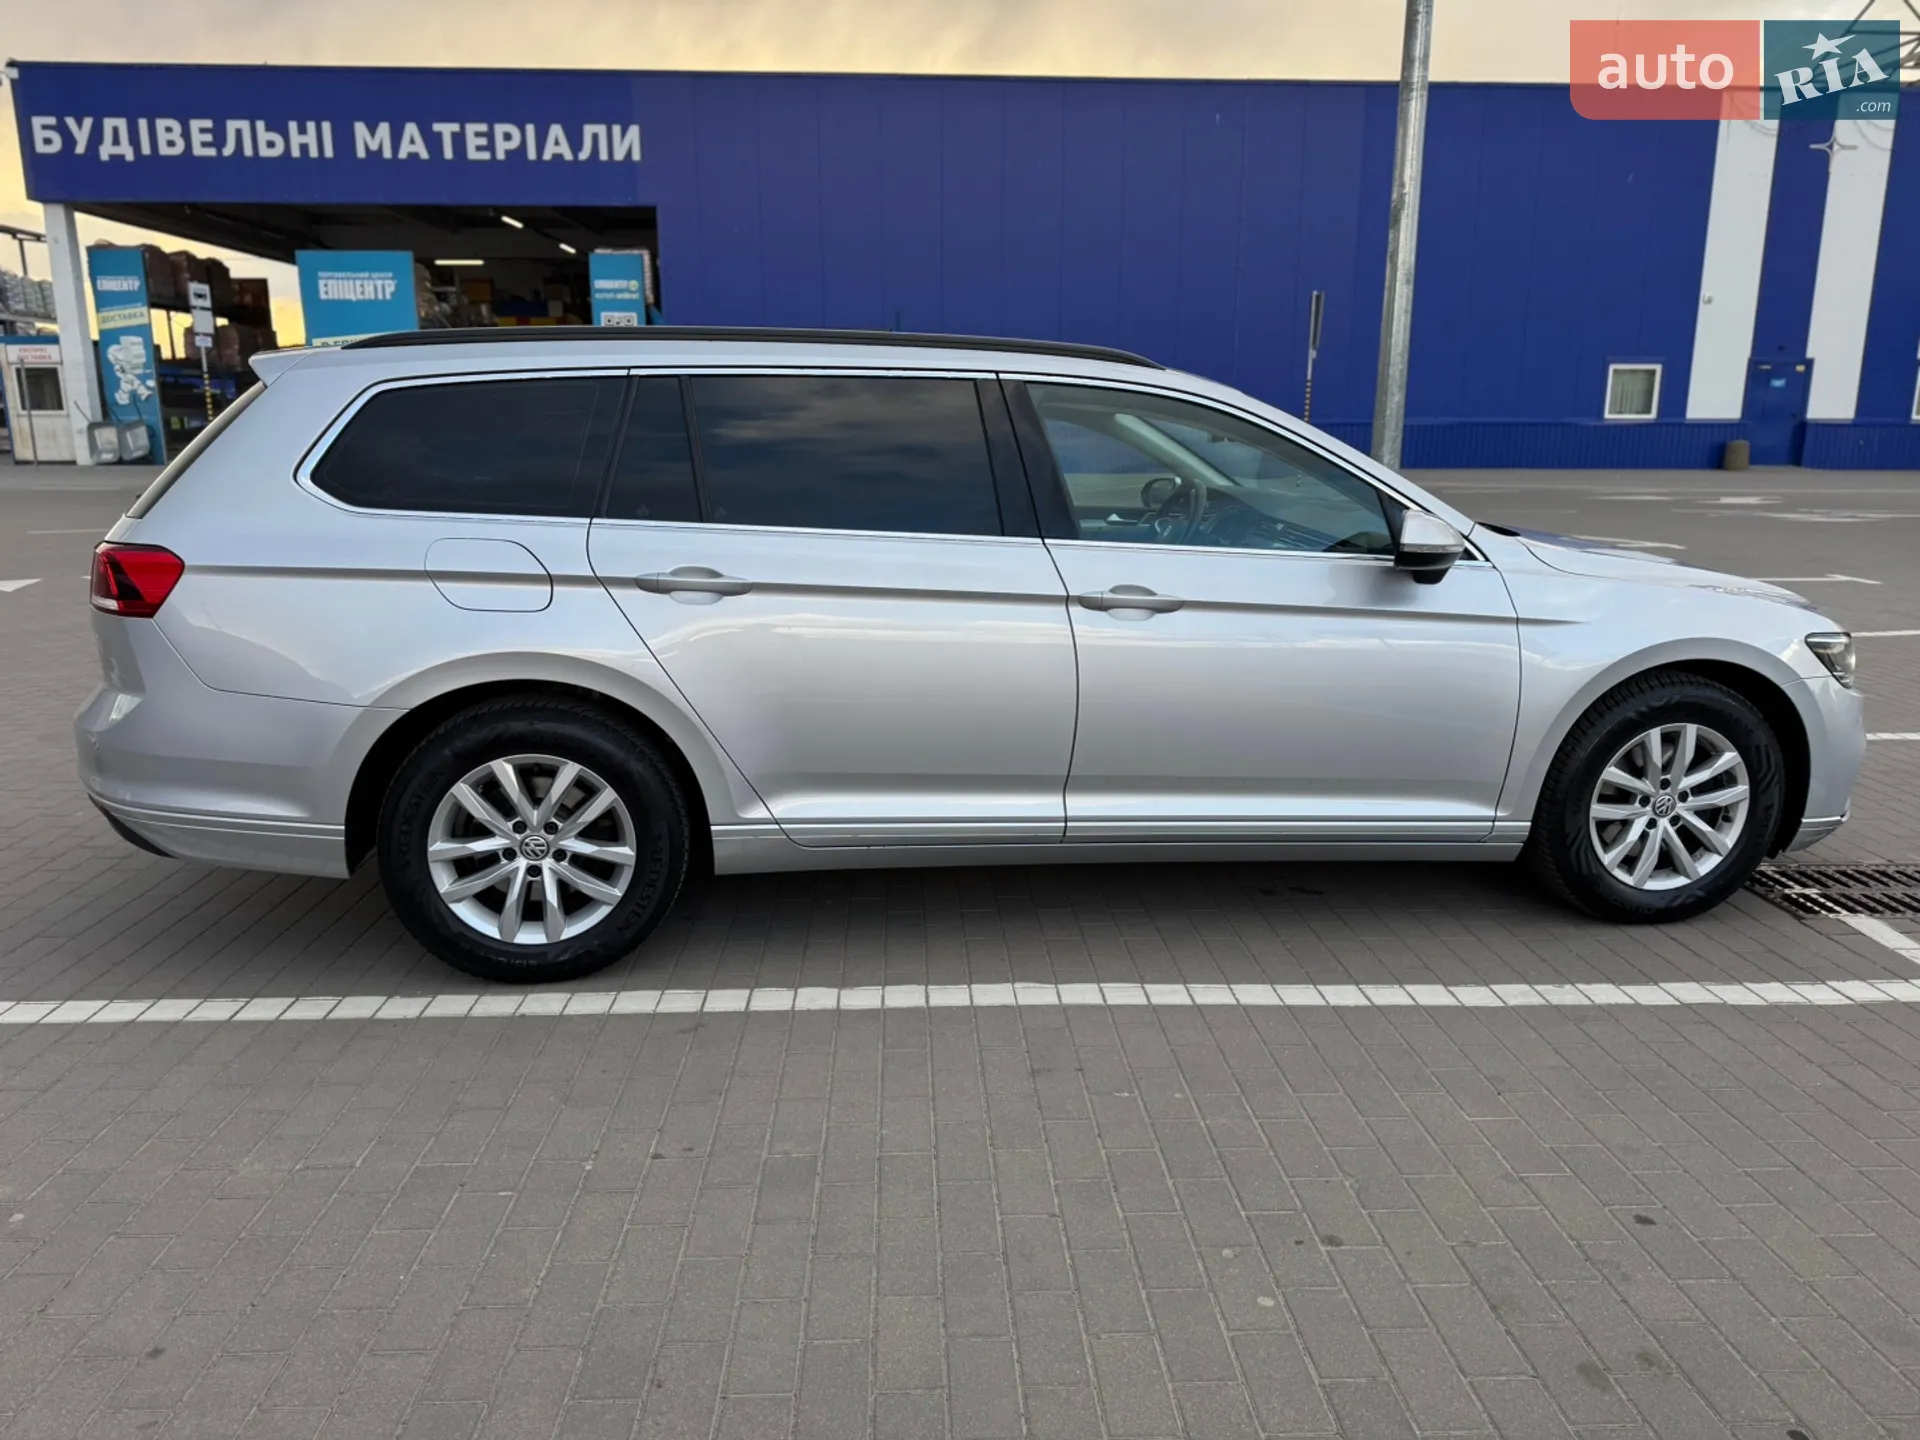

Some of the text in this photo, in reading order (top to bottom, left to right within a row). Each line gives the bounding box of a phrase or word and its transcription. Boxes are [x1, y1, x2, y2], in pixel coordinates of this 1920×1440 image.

[30, 115, 642, 162] БУДІВЕЛЬНІ МАТЕРІАЛИ
[318, 279, 395, 301] ЕПІЦЕНТР
